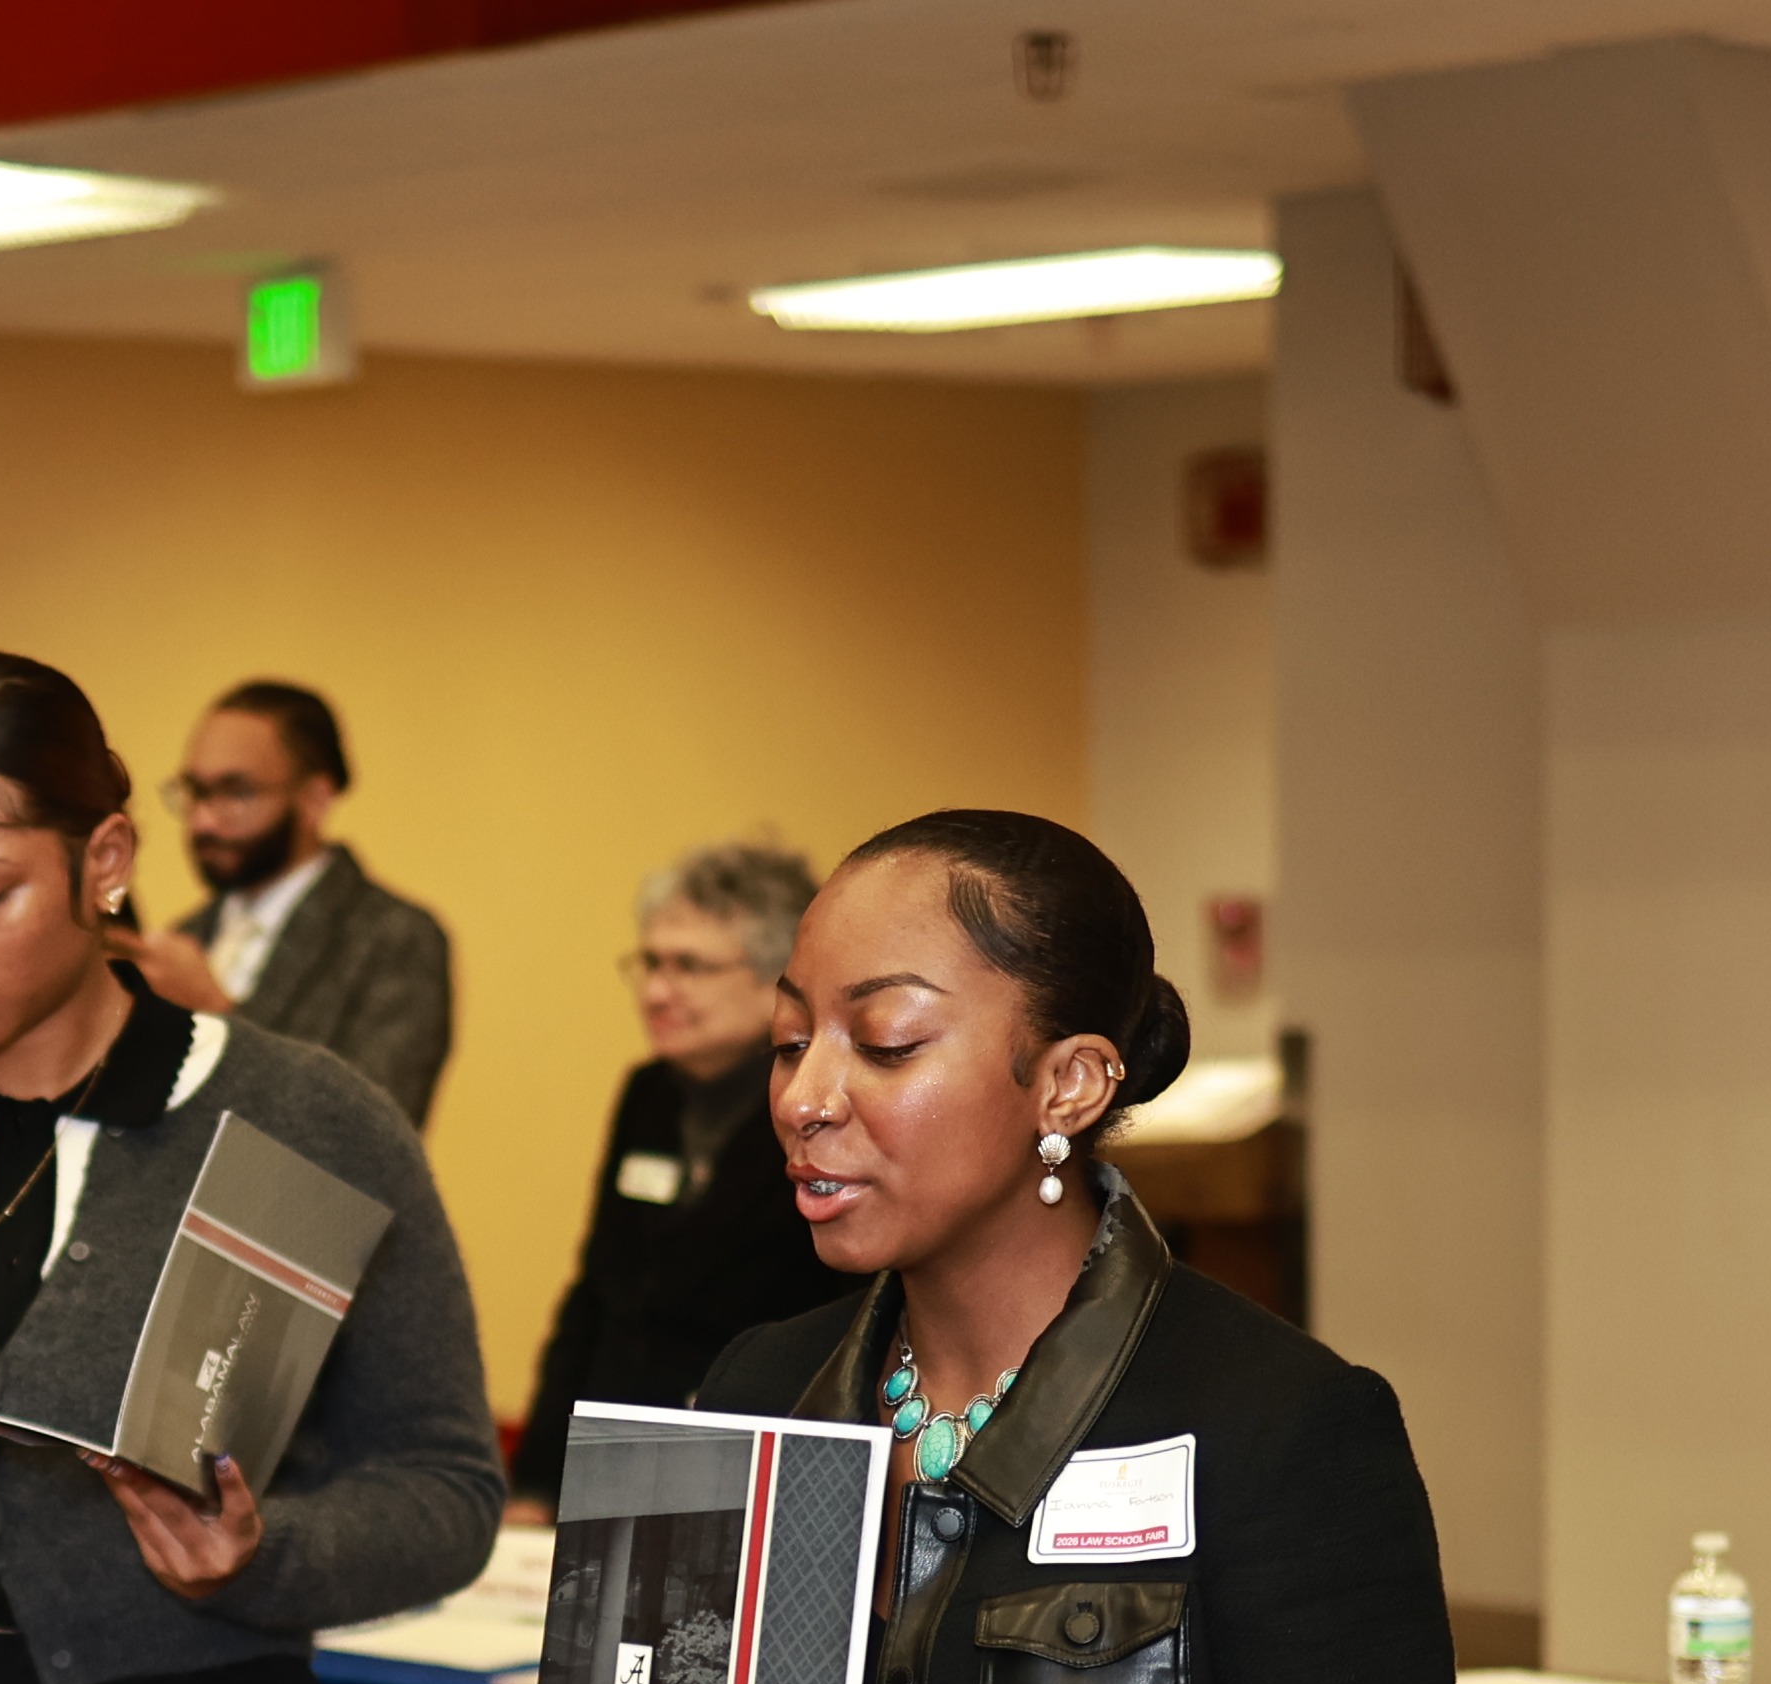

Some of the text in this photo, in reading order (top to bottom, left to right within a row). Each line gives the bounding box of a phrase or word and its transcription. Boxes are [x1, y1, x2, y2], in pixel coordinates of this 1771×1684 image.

[1056, 1530, 1165, 1546] 2026 LAW SCHOOL FAIR
